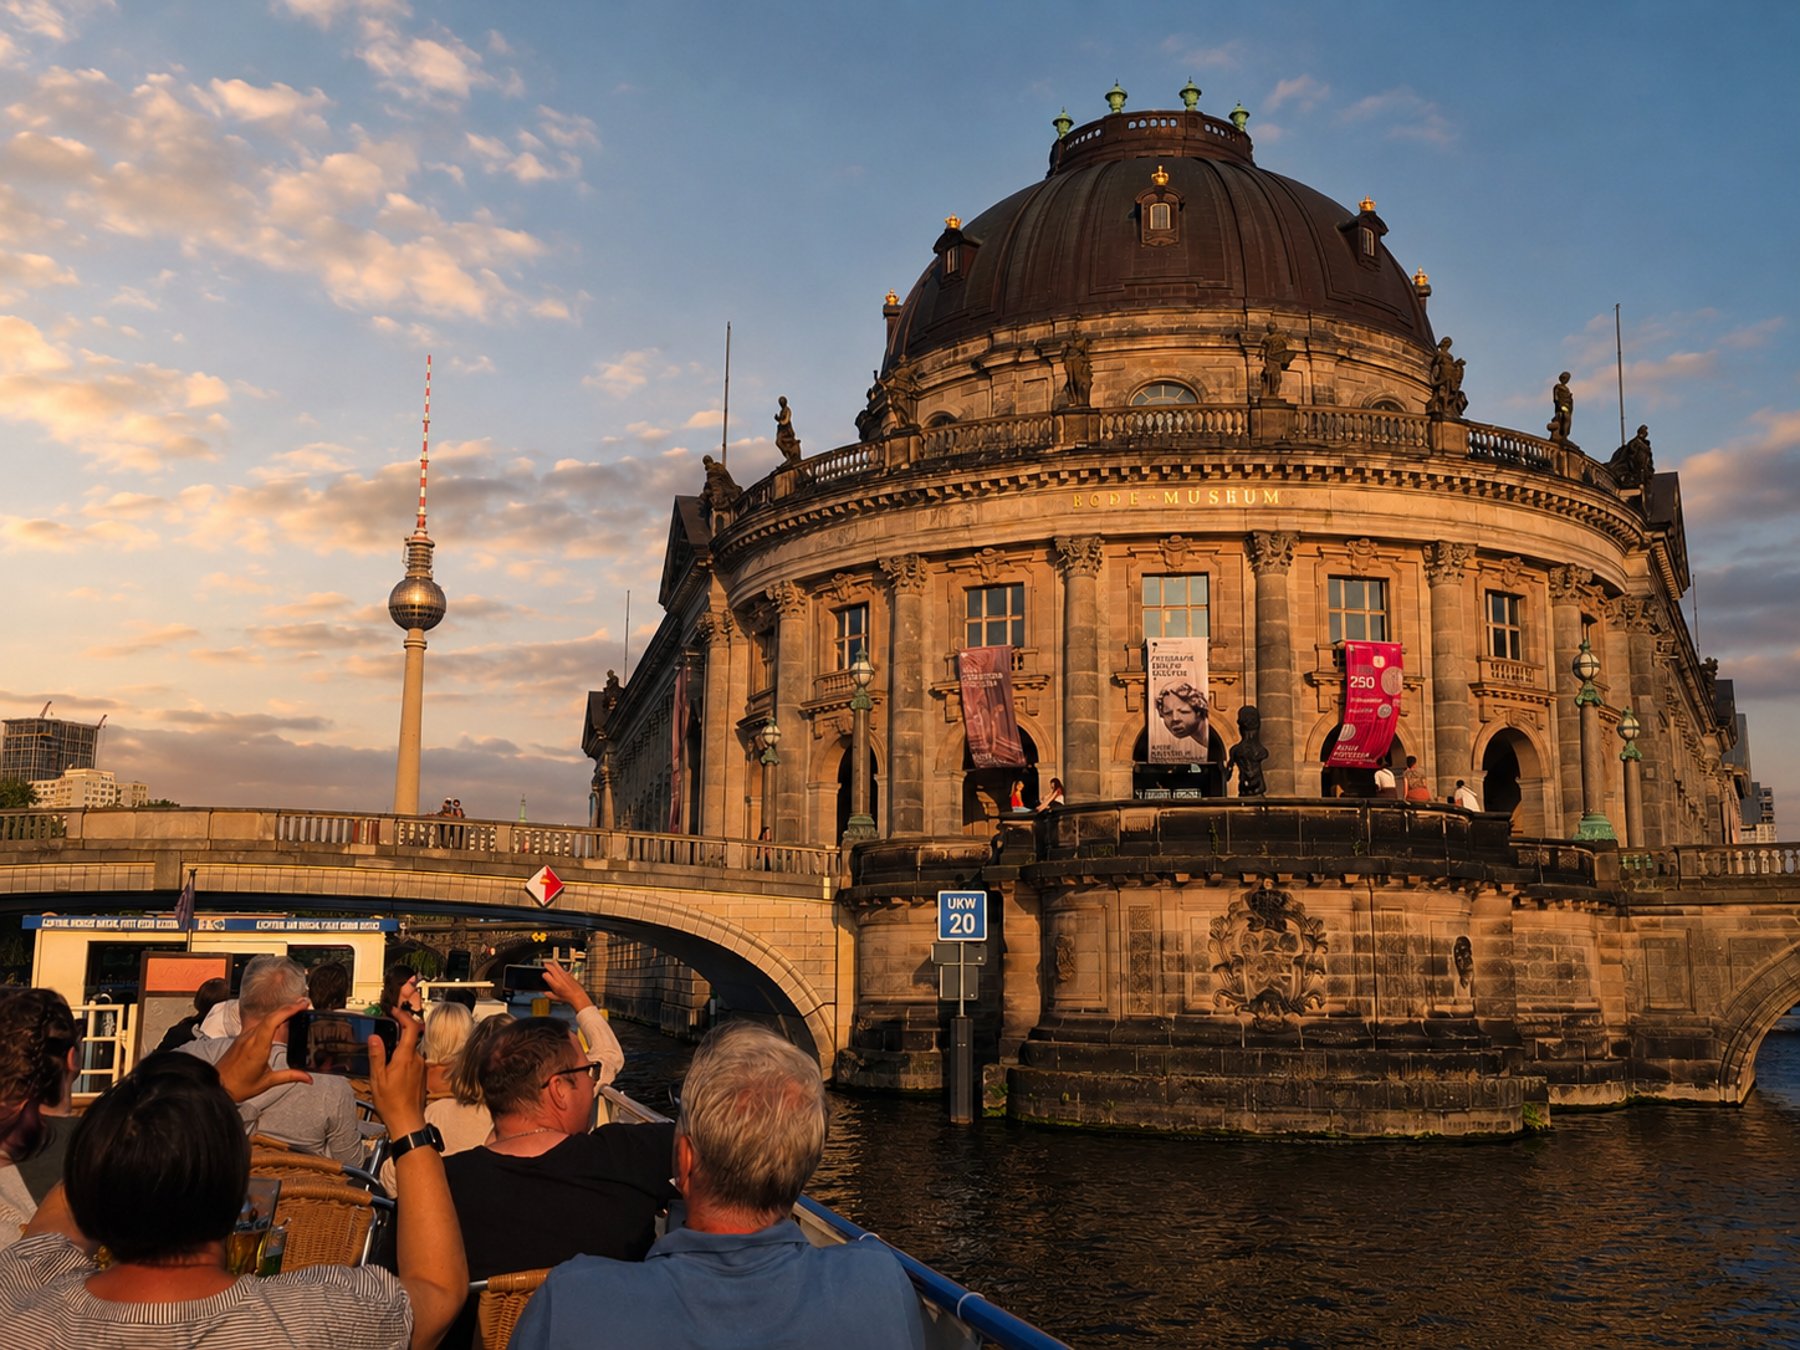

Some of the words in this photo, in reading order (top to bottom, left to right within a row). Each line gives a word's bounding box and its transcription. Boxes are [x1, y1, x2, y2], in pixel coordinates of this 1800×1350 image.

[1073, 491, 1139, 508] BODE
[1164, 489, 1280, 505] MUSEUM
[1350, 675, 1375, 689] 250
[947, 897, 977, 910] UKW
[949, 912, 976, 934] 20
